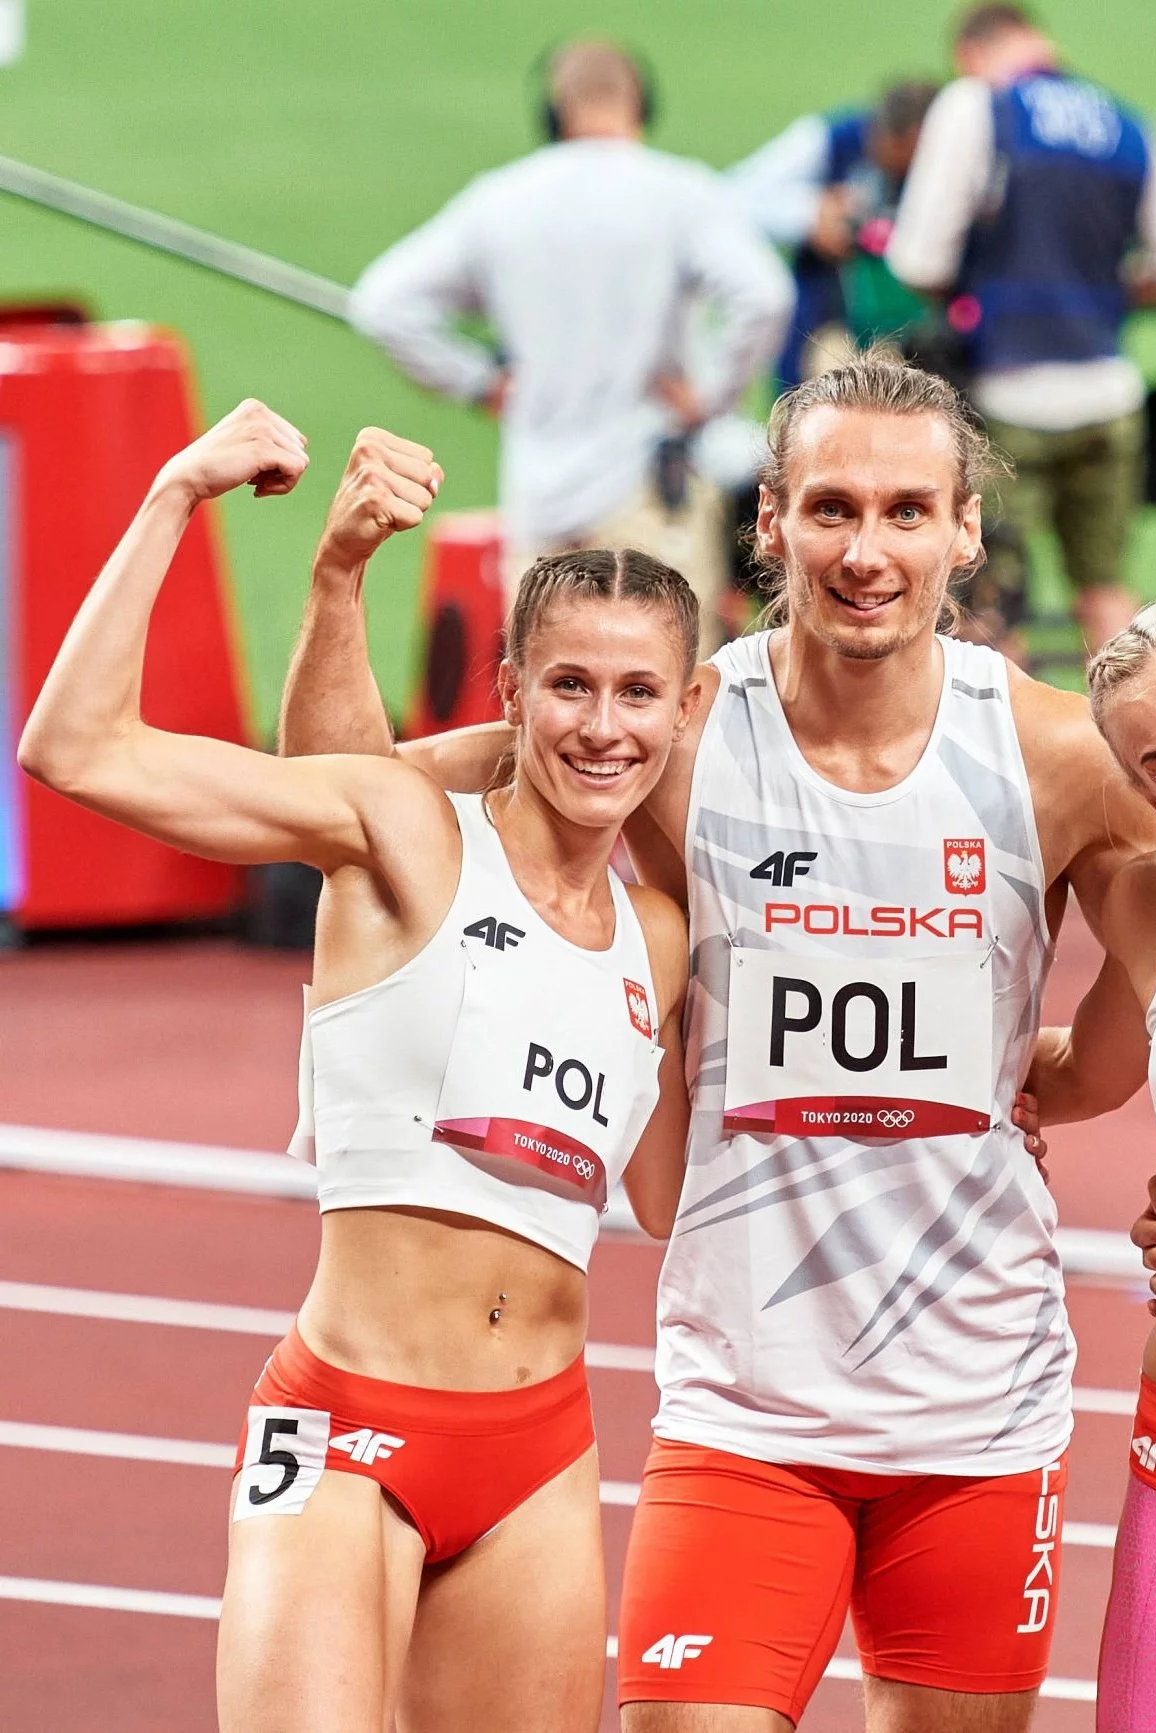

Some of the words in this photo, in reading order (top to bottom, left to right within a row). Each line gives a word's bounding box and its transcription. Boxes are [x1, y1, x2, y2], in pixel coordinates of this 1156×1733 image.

[946, 840, 982, 849] POLSKA
[750, 850, 818, 887] 4F
[463, 916, 526, 951] 4F
[765, 902, 982, 938] POLSKA
[769, 976, 947, 1072] POL
[523, 1042, 608, 1128] POL
[801, 1111, 840, 1124] TOKYO
[843, 1112, 873, 1124] 2020
[513, 1133, 547, 1156] TOKYO
[546, 1148, 570, 1166] 2020
[249, 1418, 301, 1505] 5
[328, 1428, 406, 1465] 4F
[641, 1633, 714, 1669] 4F
